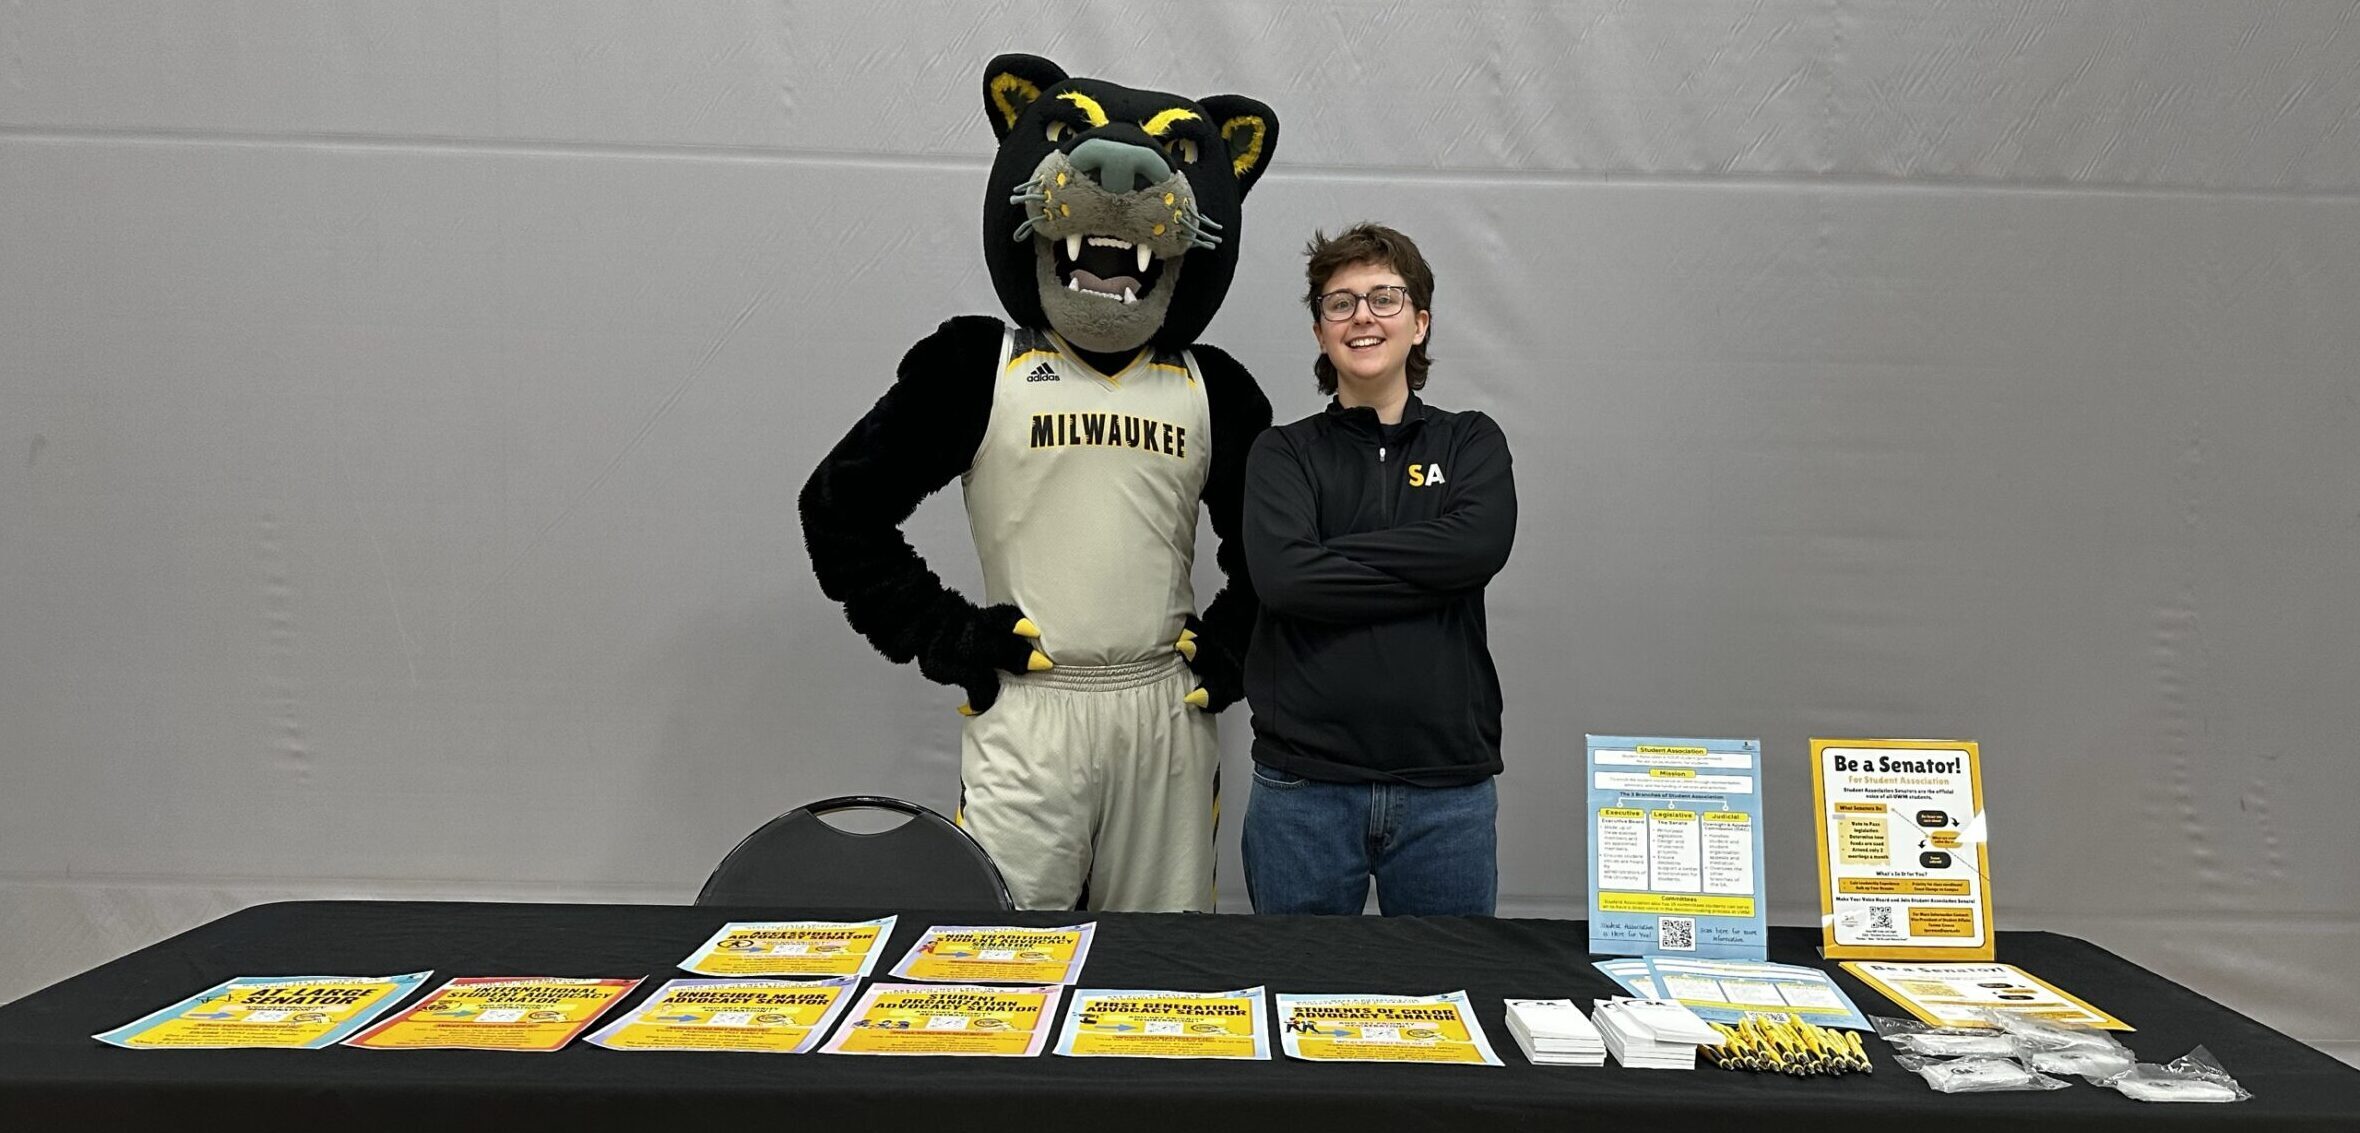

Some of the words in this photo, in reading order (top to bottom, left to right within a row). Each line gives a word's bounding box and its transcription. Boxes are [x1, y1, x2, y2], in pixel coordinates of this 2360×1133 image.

[1030, 413, 1186, 459] MILWAUKEE
[1408, 463, 1446, 486] SA
[1834, 755, 1858, 772] Be
[1863, 760, 1874, 772] a
[1879, 756, 1961, 774] Senator!
[1864, 776, 1897, 784] Student
[1900, 777, 1949, 785] Association
[249, 988, 379, 996] AT-LARGE
